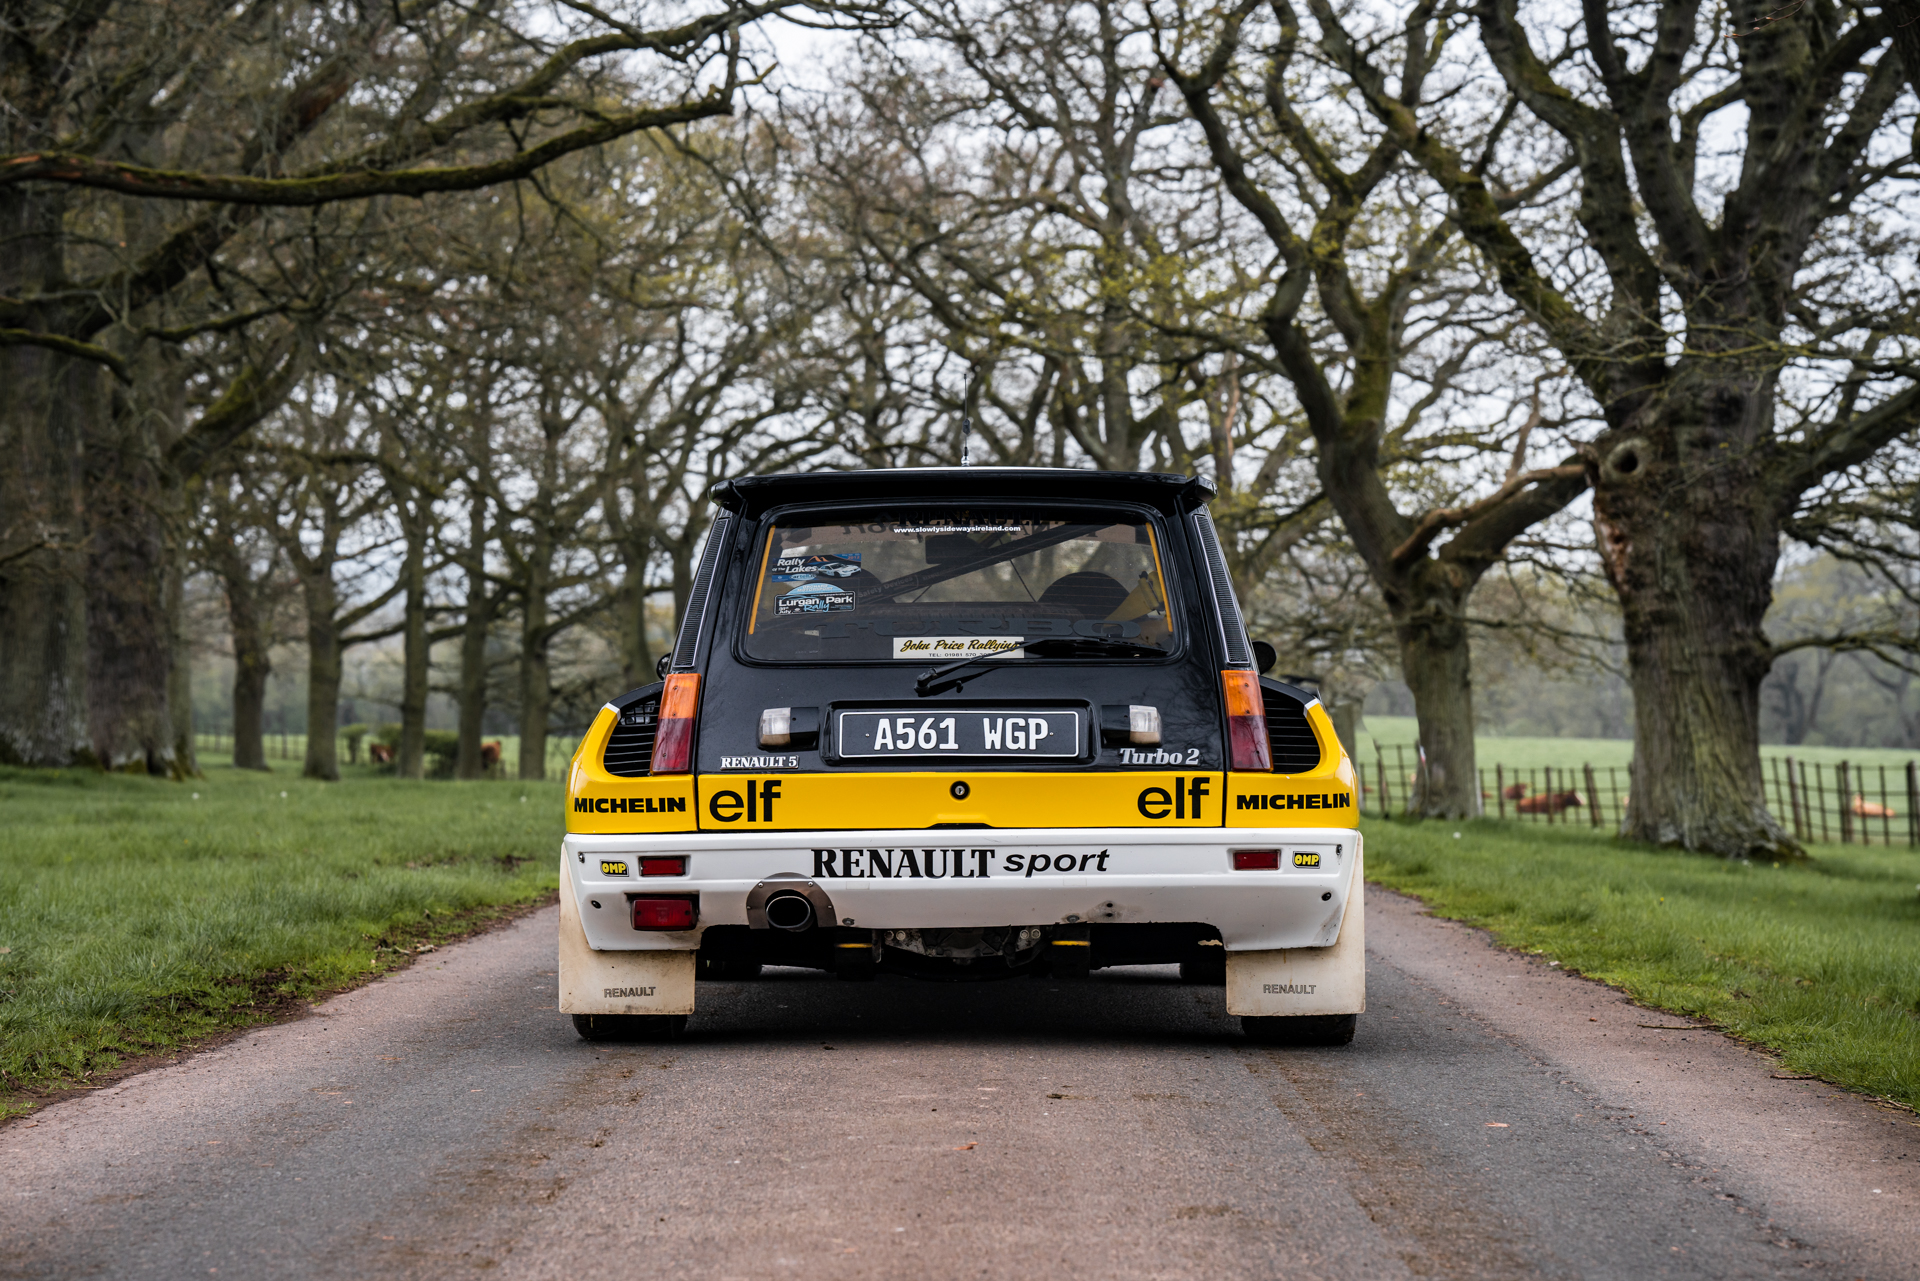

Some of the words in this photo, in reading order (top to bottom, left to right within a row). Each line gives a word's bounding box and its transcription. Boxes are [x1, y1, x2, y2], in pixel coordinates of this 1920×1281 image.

[893, 525, 1021, 533] www.slowlysidewaysireland.com
[777, 557, 806, 567] Rally
[785, 565, 818, 574] Lakes
[779, 599, 819, 608] Lurgan
[825, 596, 853, 604] Park
[803, 600, 830, 613] Rally
[900, 640, 931, 652] John
[934, 639, 965, 650] Price
[967, 639, 1020, 653] Rallying
[873, 718, 960, 751] A561
[982, 717, 1049, 750] WGP
[720, 756, 785, 769] RENAULT
[787, 755, 798, 769] 5
[1119, 748, 1183, 766] Turbo
[1184, 748, 1200, 765] 2
[709, 779, 782, 823] elf
[1137, 777, 1210, 819] elf
[1236, 792, 1350, 810] MICHELIN
[574, 797, 686, 814] MICHELIN
[811, 849, 995, 878] RENAULT
[1003, 848, 1110, 878] sport
[1294, 853, 1318, 866] OMP
[601, 861, 627, 874] OMP
[604, 986, 656, 998] RENAULT
[1263, 984, 1316, 995] RENAULT
